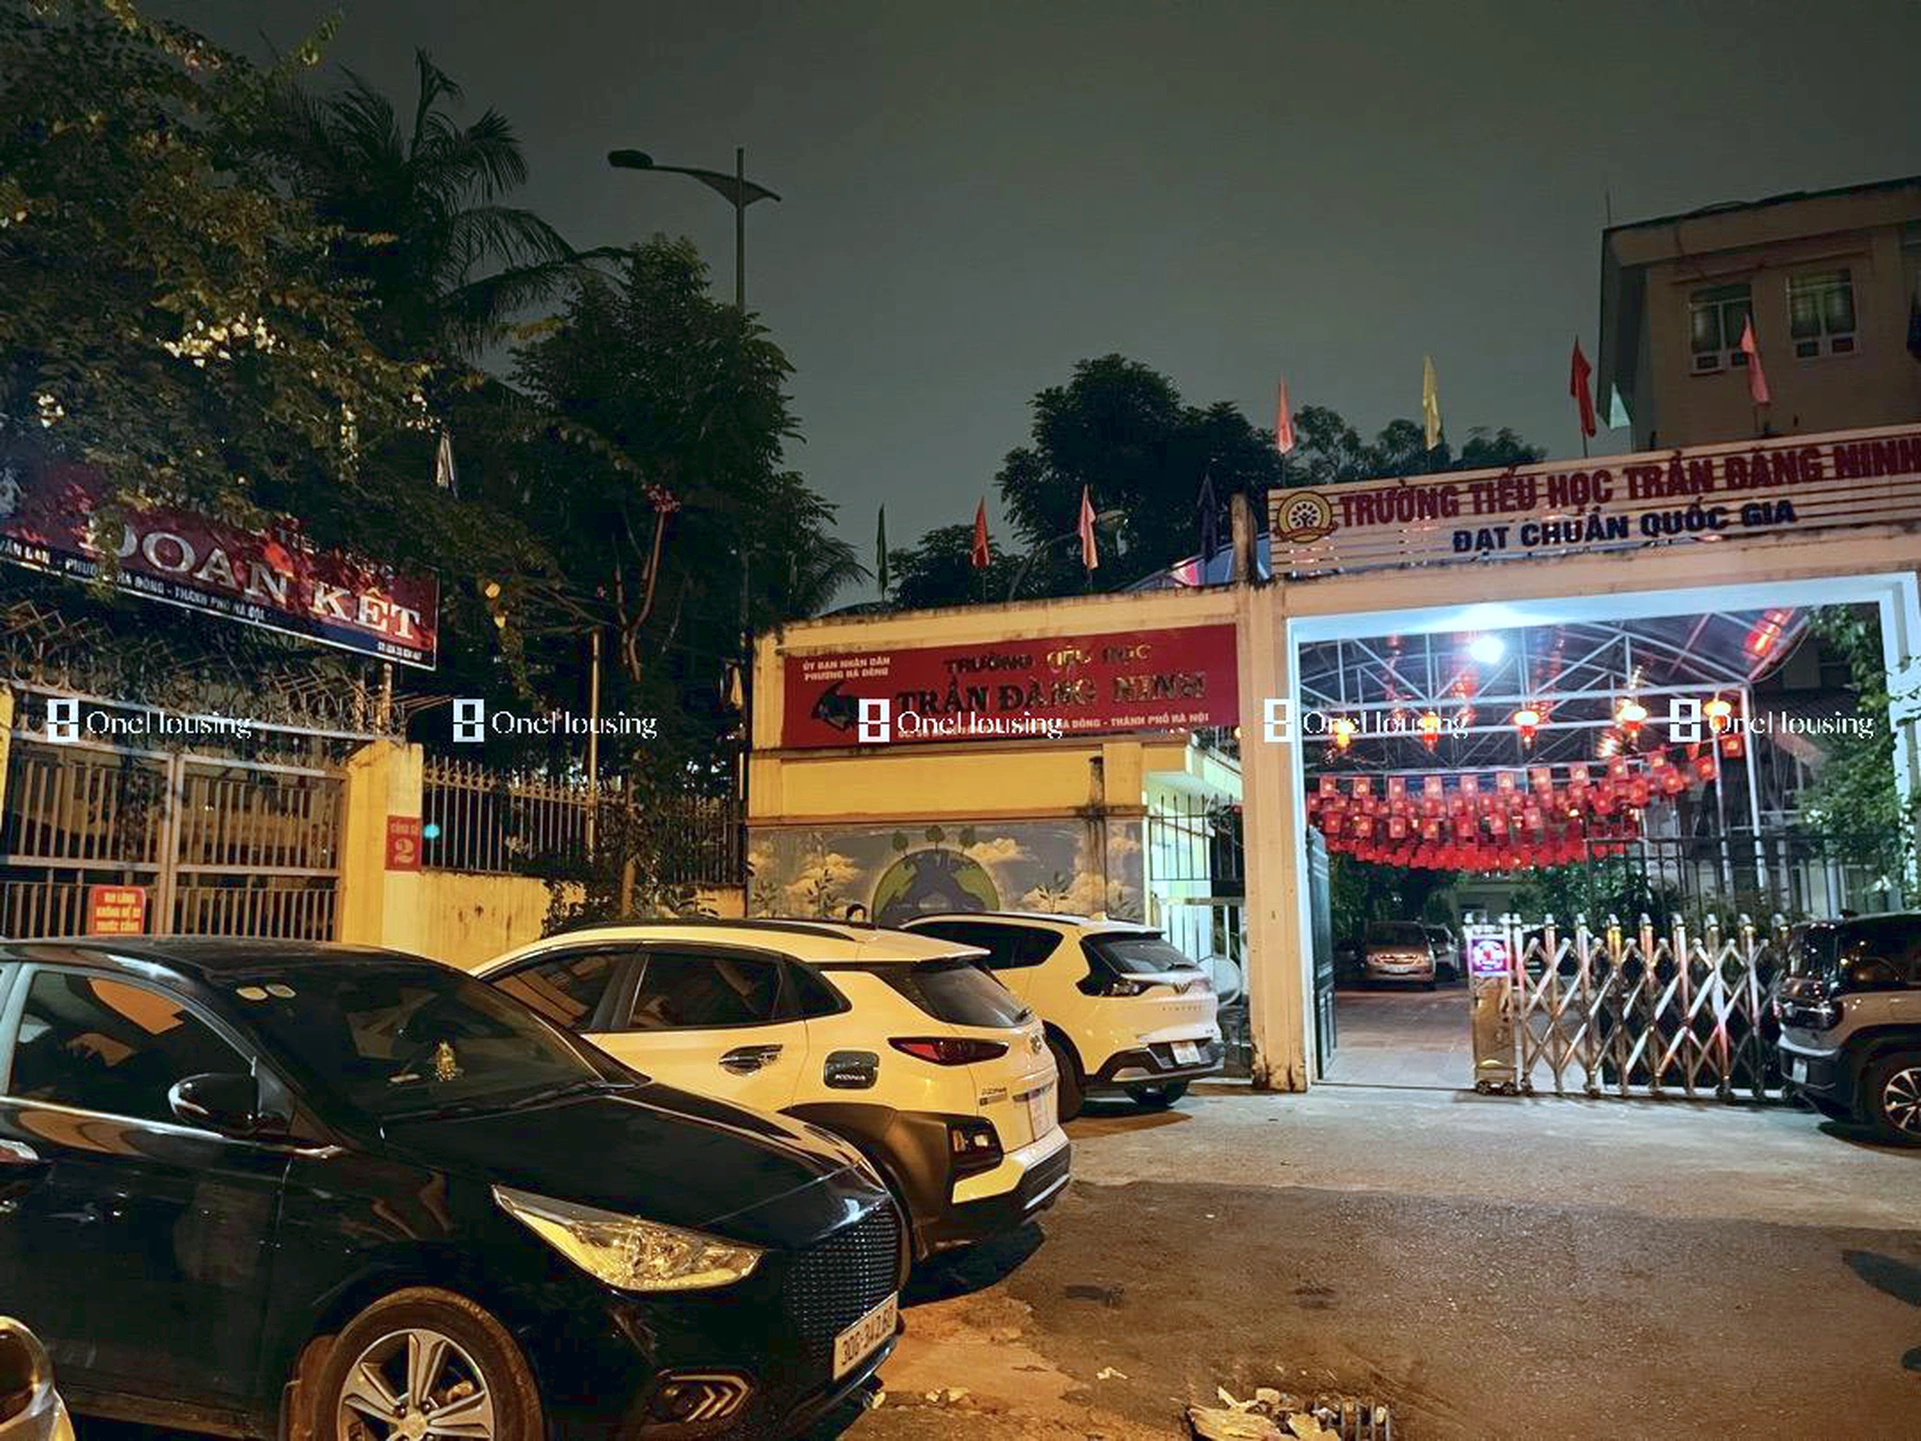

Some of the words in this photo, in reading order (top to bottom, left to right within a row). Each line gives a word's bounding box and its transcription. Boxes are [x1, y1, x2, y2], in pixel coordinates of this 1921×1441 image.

[1336, 479, 1460, 527] TRƯỜNG
[1468, 463, 1537, 515] TIỂU
[1547, 469, 1614, 516] HỌC
[1832, 437, 1921, 481] NINH
[1452, 526, 1509, 557] ĐẠT
[1520, 504, 1629, 548] CHUẨN
[1640, 495, 1730, 538] QUỐC
[1741, 498, 1798, 528] GIA
[817, 661, 838, 670] BAN
[840, 657, 868, 669] NHÂN
[869, 655, 891, 667] DÂN
[1110, 713, 1146, 727] THÀNH
[1148, 711, 1170, 725] PHỐ
[395, 838, 415, 865] 2
